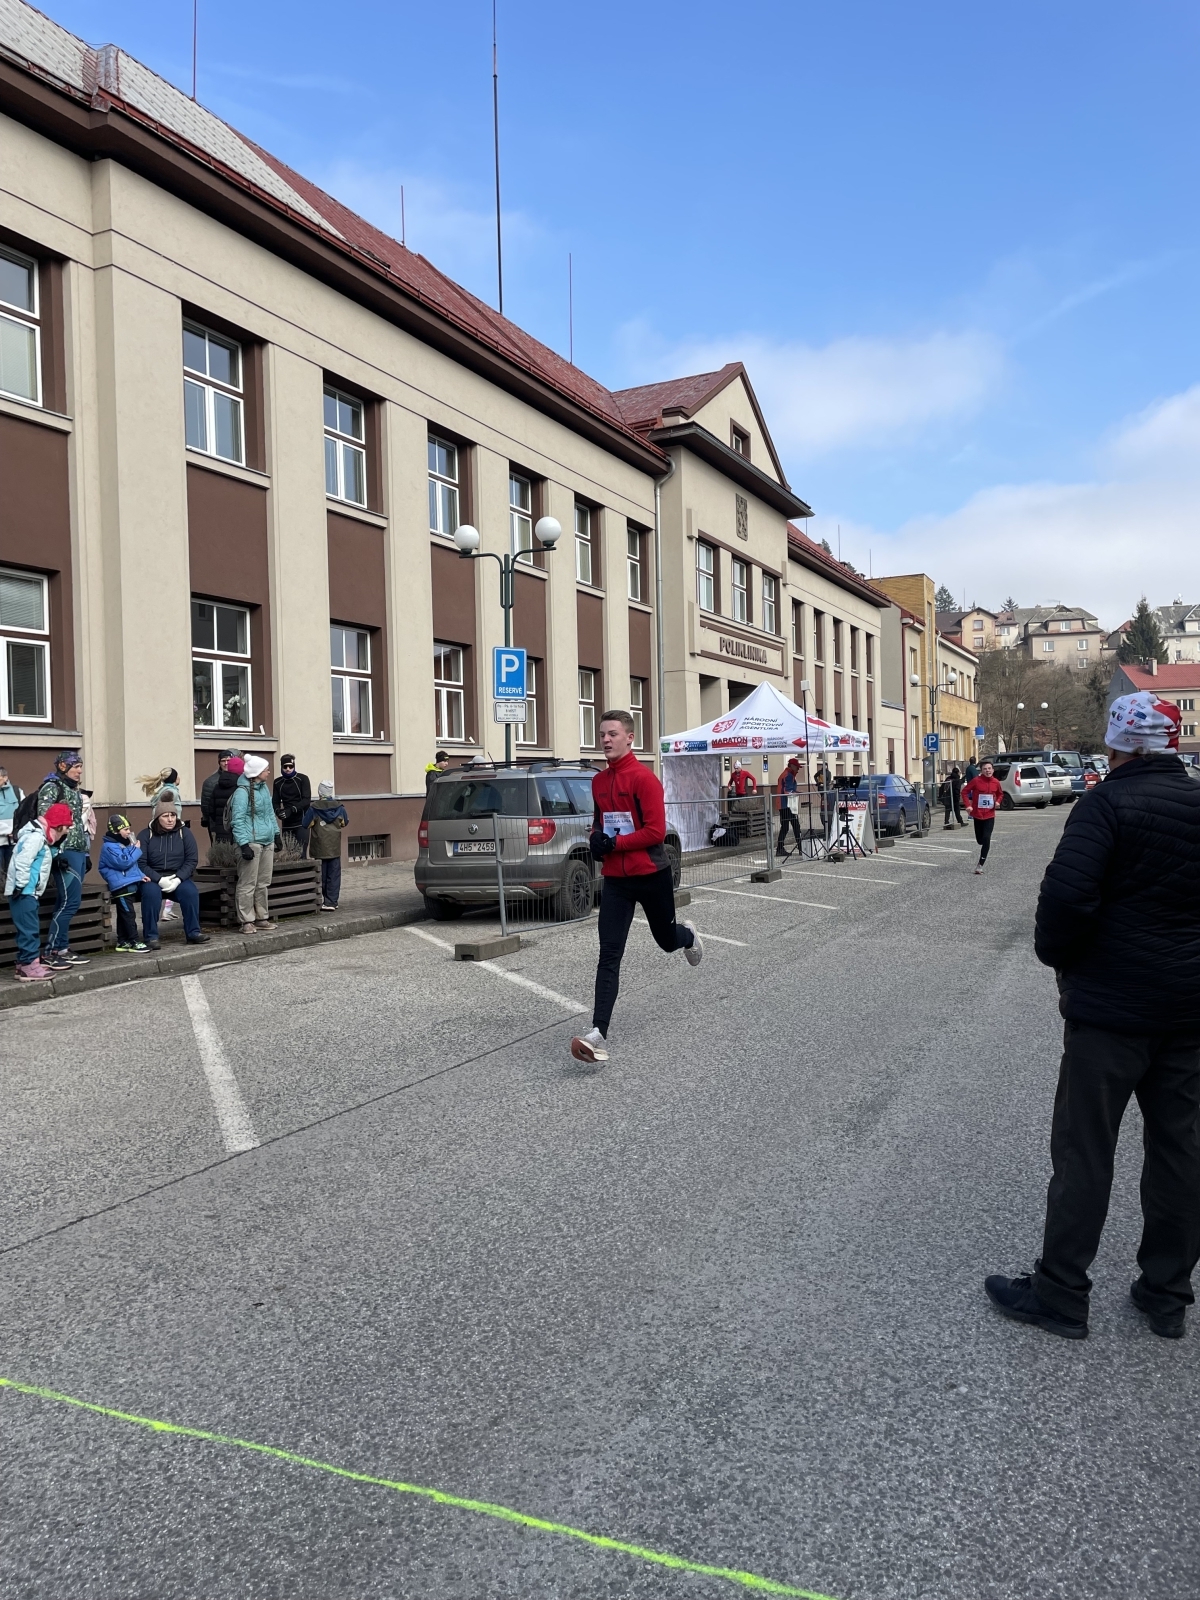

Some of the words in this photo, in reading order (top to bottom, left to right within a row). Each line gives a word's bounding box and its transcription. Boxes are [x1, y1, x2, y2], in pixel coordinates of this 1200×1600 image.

[719, 636, 767, 664] POLIKLINIKA
[501, 654, 520, 682] P
[498, 686, 523, 694] RESERVÉ
[711, 736, 747, 745] MARATON
[928, 735, 937, 747] P
[477, 842, 495, 852] 2459
